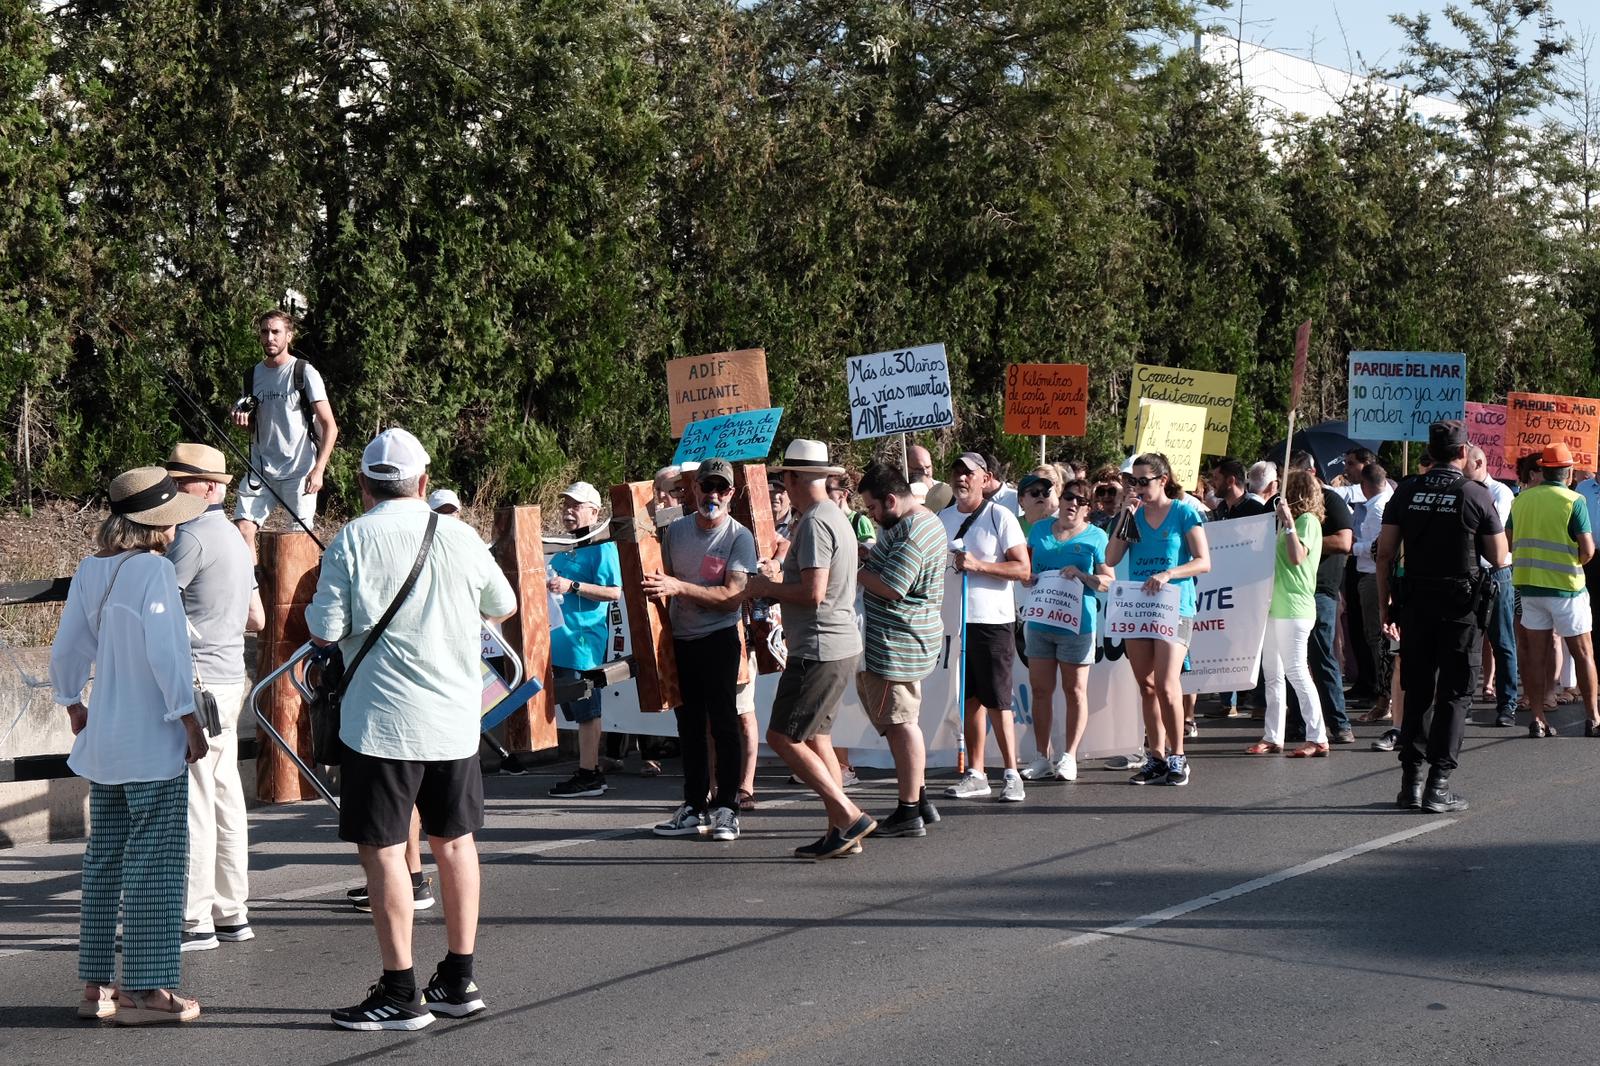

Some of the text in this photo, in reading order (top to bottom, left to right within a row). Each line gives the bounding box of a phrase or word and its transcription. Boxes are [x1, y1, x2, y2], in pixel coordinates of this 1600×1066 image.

[849, 351, 945, 384] Más de 30 años
[1008, 364, 1073, 387] 8 Kilómetros
[1137, 367, 1194, 387] Corredor
[1353, 362, 1403, 378] PARQUE
[1405, 363, 1429, 378] DEL
[851, 374, 950, 407] de vías muertas
[1008, 386, 1085, 408] de costa pierde
[1352, 383, 1461, 409] 10 años ya sin
[1008, 402, 1078, 416] Alicante con
[1513, 399, 1556, 413] PARQUE
[1571, 403, 1597, 416] MAR
[688, 413, 774, 437] La playa de
[855, 402, 953, 435] ADIF entiérralas
[1021, 415, 1061, 429] el tren
[1170, 421, 1197, 433] muro
[1352, 403, 1462, 436] poder pasar
[683, 424, 773, 447] SAN GABRIEL
[683, 434, 768, 455] nos la roba
[1146, 430, 1157, 446] de
[1516, 431, 1582, 449] pero NO
[1044, 597, 1071, 609] LITORAL
[1135, 602, 1174, 612] OCUPANDO
[1047, 608, 1079, 627] AÑOS
[1135, 611, 1166, 619] LITORAL
[1111, 620, 1174, 637] 139 AÑOS
